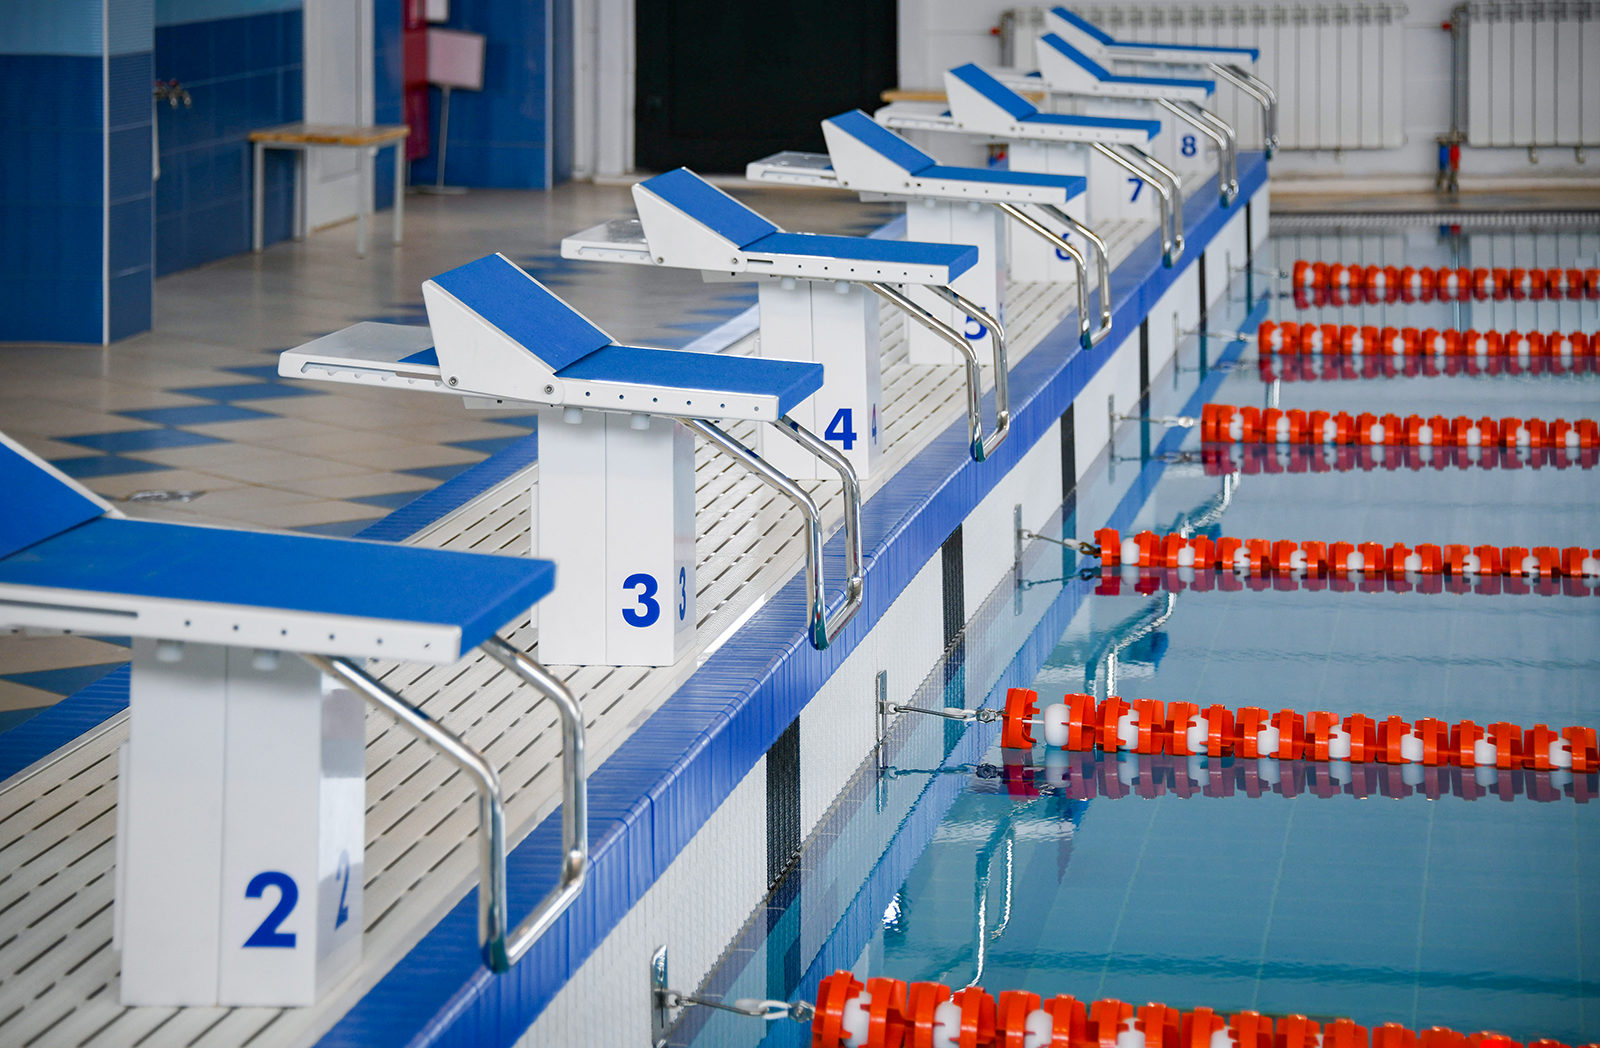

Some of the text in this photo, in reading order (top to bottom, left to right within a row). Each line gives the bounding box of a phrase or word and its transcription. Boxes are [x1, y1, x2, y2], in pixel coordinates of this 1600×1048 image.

[1182, 135, 1196, 157] 8
[1128, 178, 1143, 202] 7
[825, 408, 857, 450] 4
[622, 573, 660, 628] 3
[679, 566, 686, 621] 3
[242, 870, 299, 948] 2
[335, 849, 350, 930] 2
